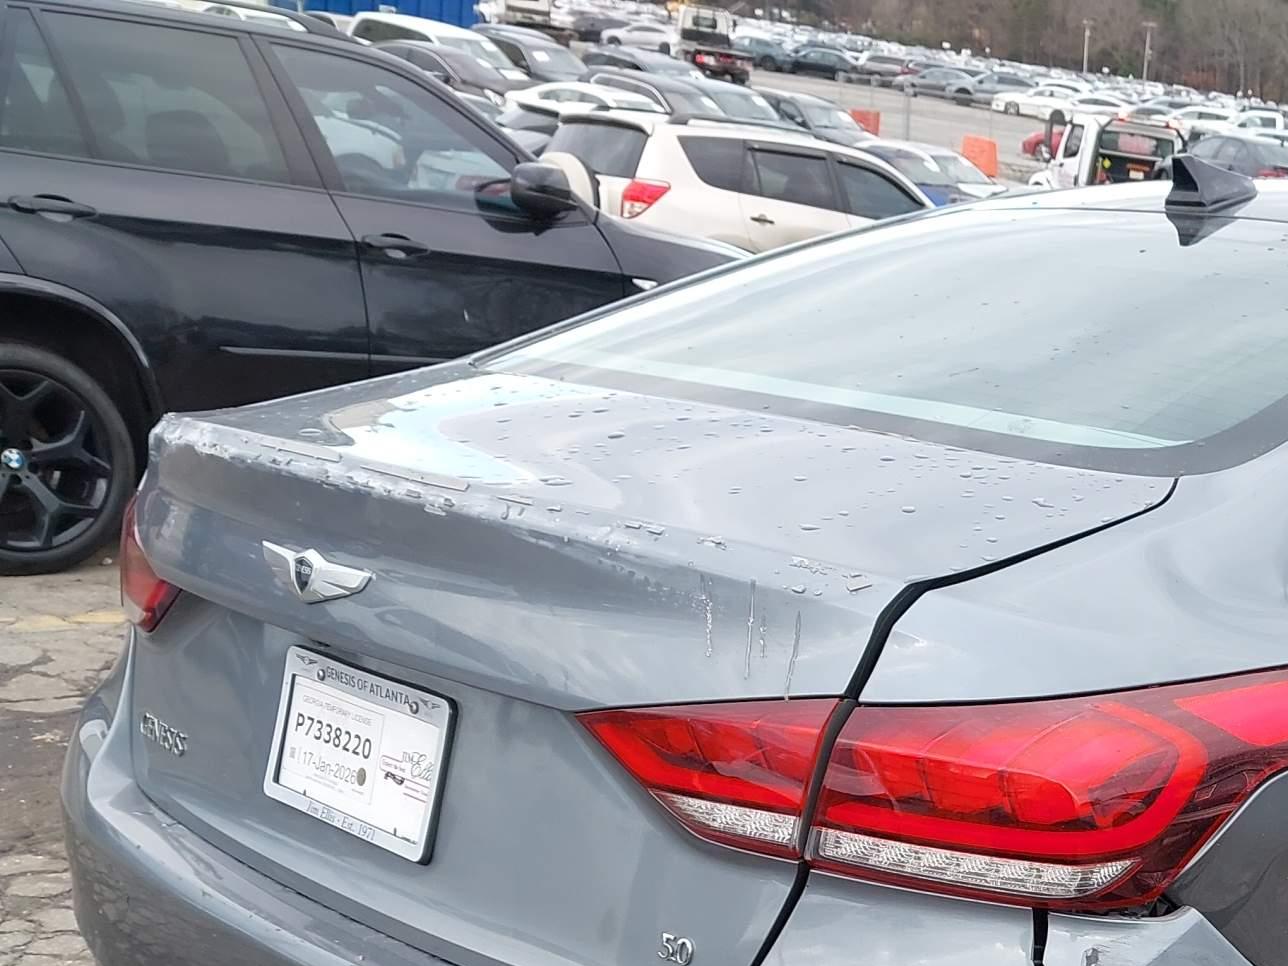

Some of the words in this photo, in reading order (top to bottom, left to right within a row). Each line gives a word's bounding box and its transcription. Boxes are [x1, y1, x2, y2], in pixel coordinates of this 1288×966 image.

[326, 666, 356, 688] GENESIS
[357, 678, 368, 691] OF
[369, 682, 410, 706] ATLANTA
[295, 712, 373, 759] P7338220
[303, 751, 357, 785] 17-Jan-2026
[307, 799, 319, 816] Jim
[358, 824, 376, 841] 1971
